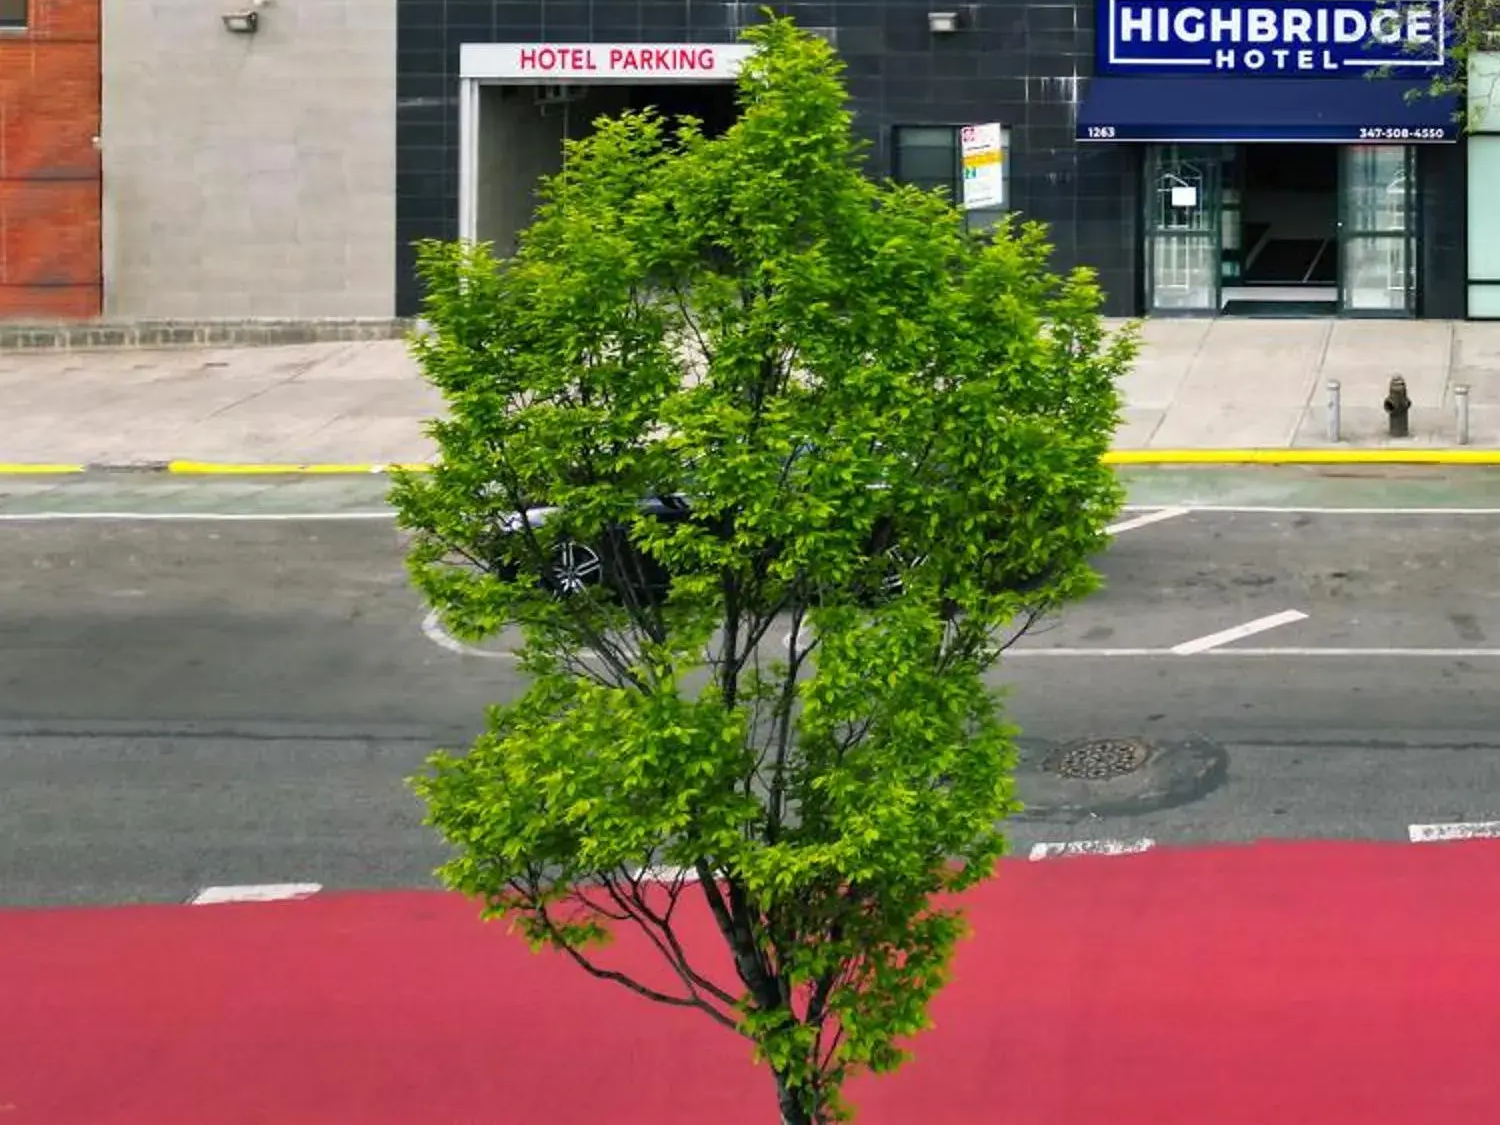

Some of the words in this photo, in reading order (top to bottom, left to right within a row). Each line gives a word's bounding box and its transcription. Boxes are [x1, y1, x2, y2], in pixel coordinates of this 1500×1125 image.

[1120, 7, 1433, 44] HIGHBRIDGE
[520, 49, 596, 70] HOTEL
[609, 49, 715, 70] PARKING
[1215, 49, 1339, 69] HOTEL
[1087, 126, 1115, 138] 1263
